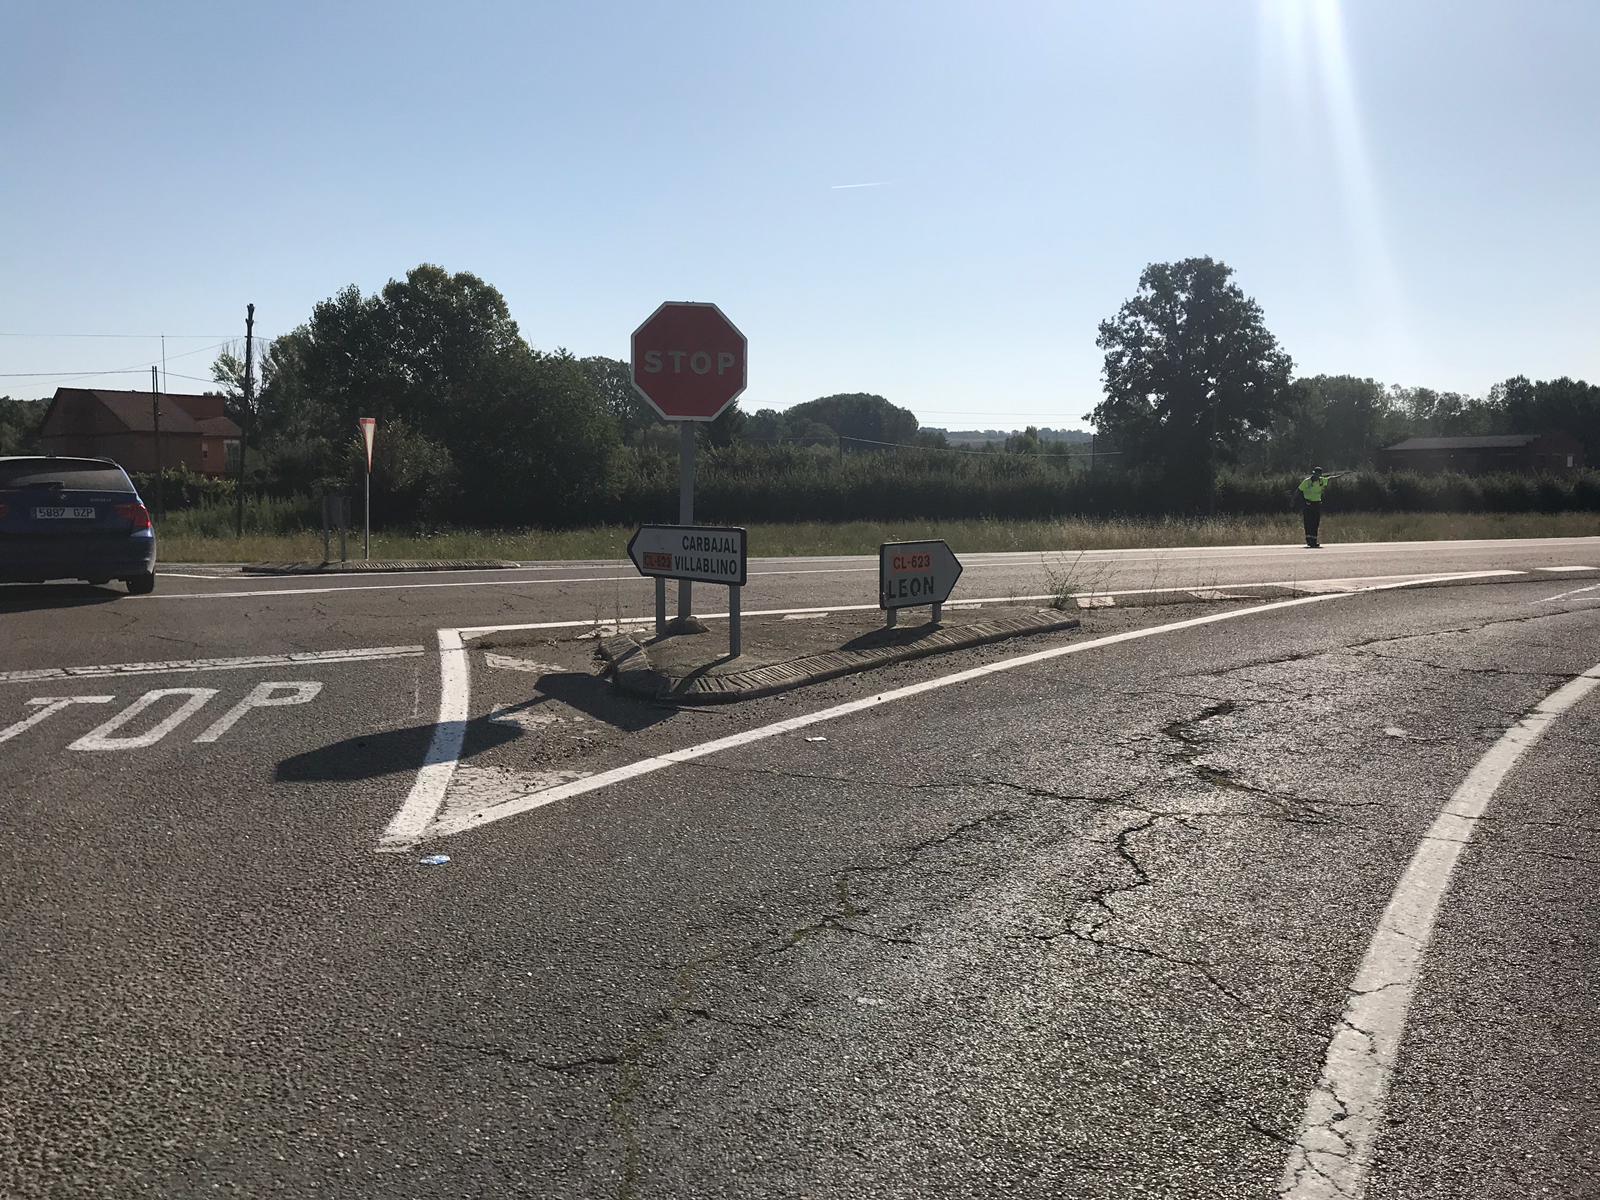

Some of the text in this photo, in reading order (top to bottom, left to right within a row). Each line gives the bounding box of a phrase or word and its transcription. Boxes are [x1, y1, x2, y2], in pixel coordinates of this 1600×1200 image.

[643, 351, 736, 375] STOP
[682, 535, 738, 554] CARBAJAL
[674, 555, 737, 575] VILLABLINO
[893, 555, 930, 569] CL-623
[887, 576, 934, 599] LEON
[0, 681, 323, 751] TOP
